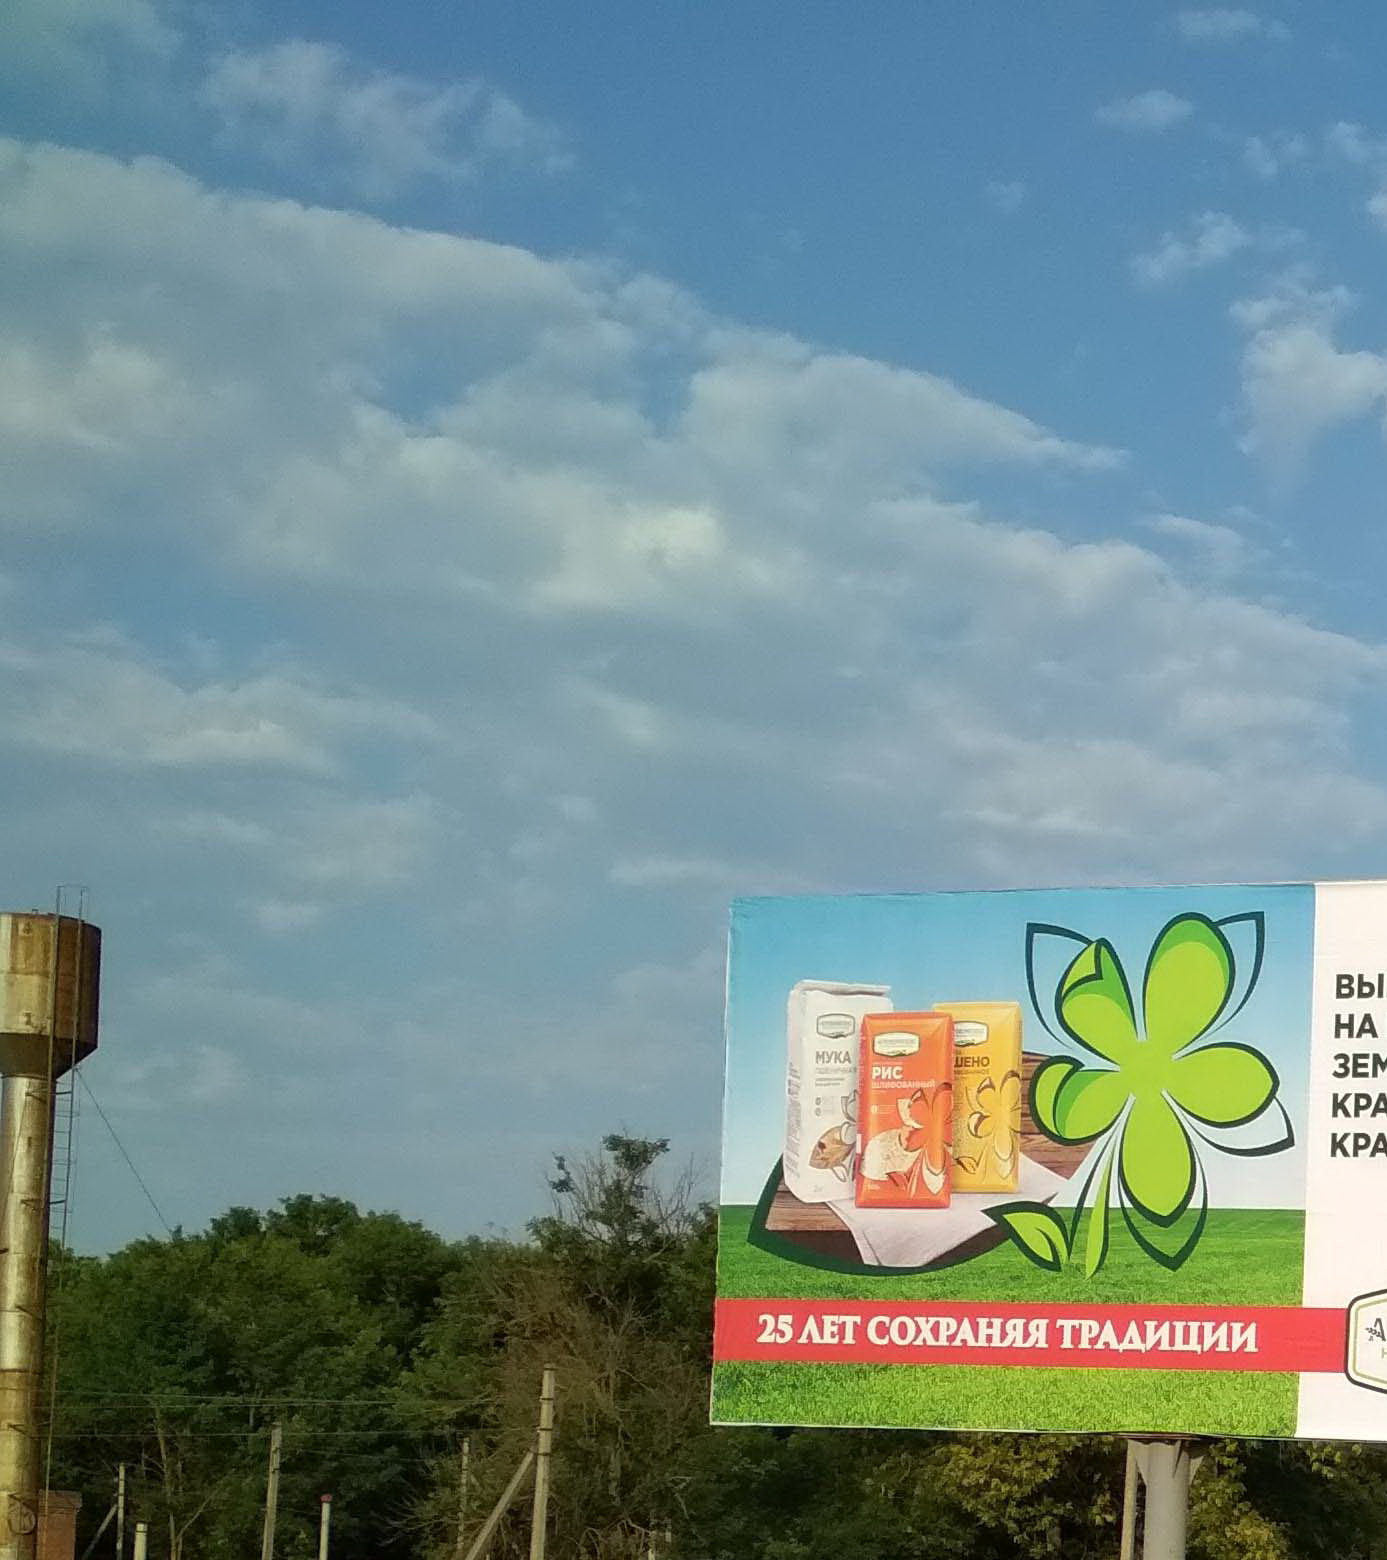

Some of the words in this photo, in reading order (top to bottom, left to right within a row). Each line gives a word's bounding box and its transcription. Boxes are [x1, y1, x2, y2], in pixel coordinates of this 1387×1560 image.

[1333, 1012, 1379, 1039] НА
[815, 1050, 852, 1064] МУКА
[953, 1055, 990, 1068] ШЕНО
[871, 1066, 903, 1080] РИС
[756, 1314, 793, 1344] 25
[797, 1314, 862, 1345] ЛЕТ
[866, 1315, 1050, 1349] СОХРАНЯЯ
[1055, 1318, 1259, 1355] ТРАДИЦИИ
